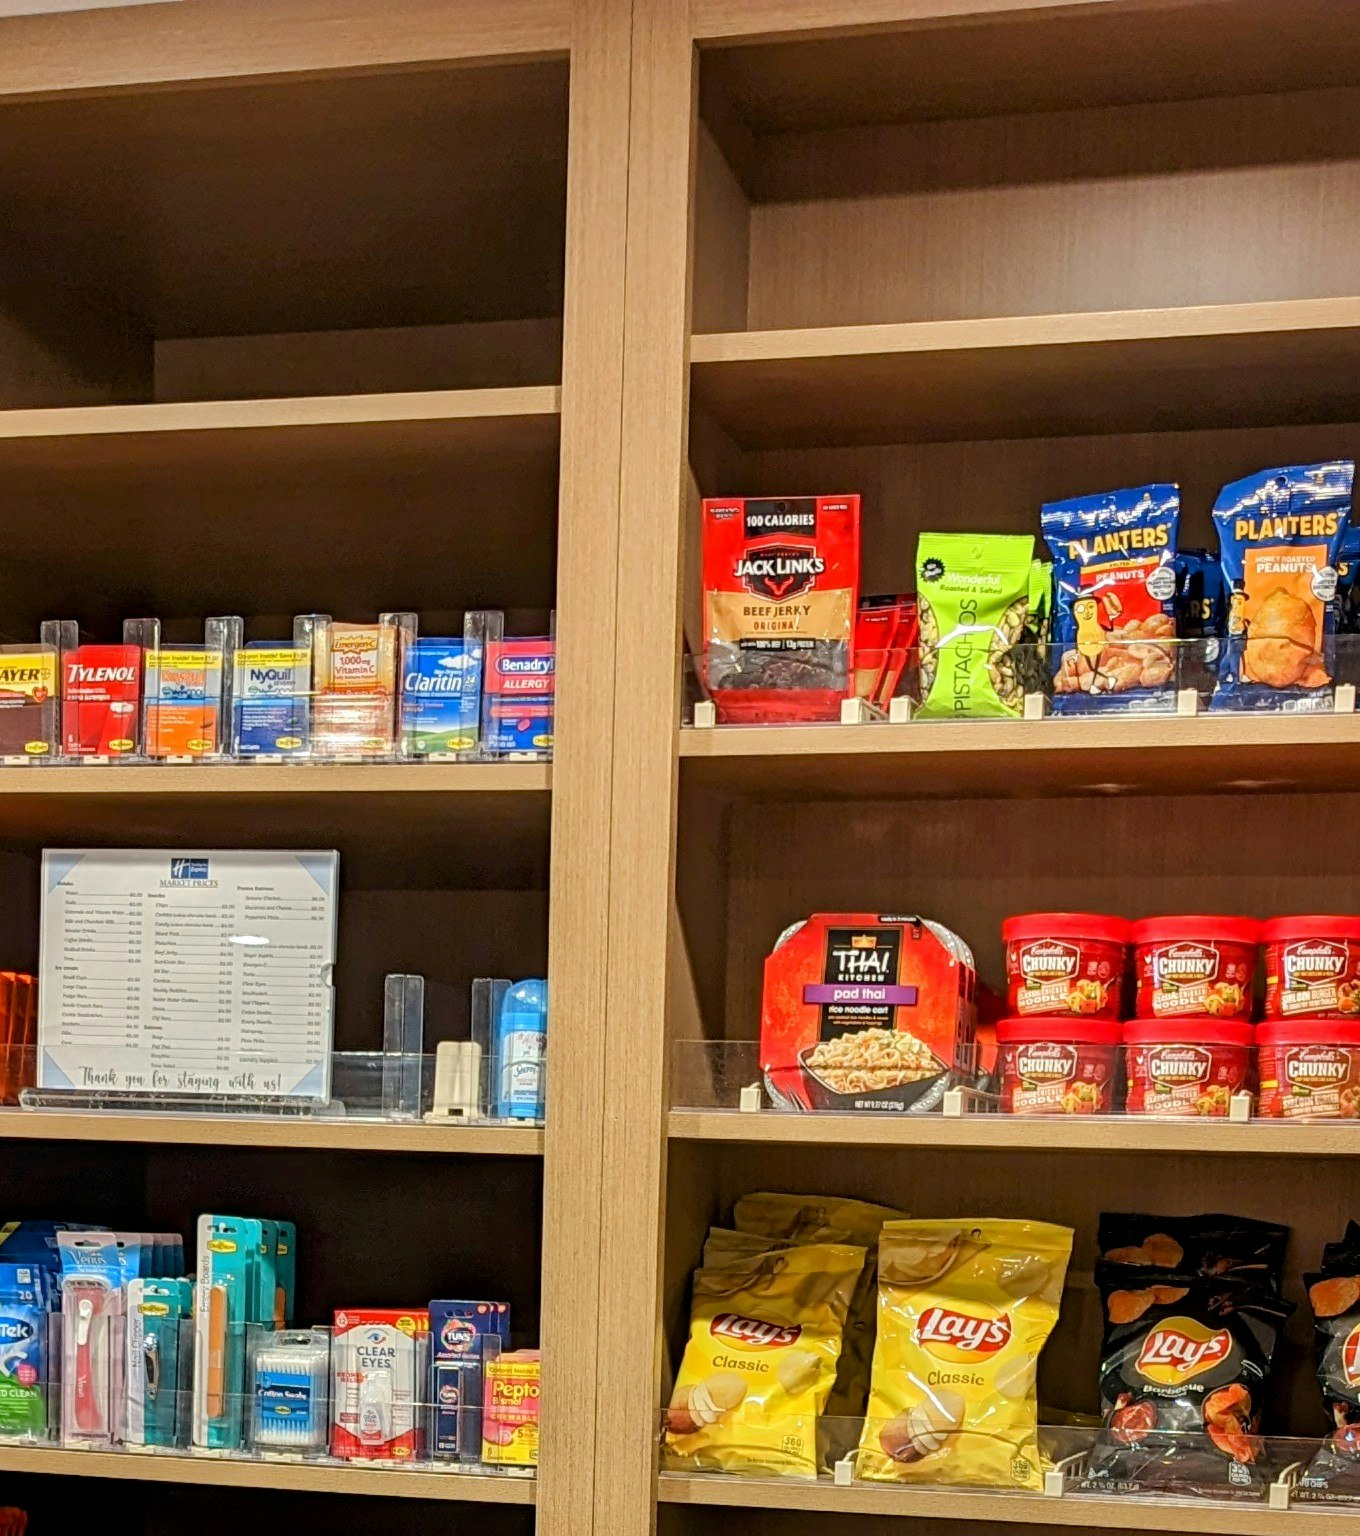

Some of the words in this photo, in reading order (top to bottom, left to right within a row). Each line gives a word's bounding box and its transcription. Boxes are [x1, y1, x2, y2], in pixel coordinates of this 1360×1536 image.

[746, 515, 764, 527] 100
[765, 514, 814, 526] CALORIES
[1236, 512, 1338, 540] PLANTERS
[1069, 526, 1169, 559] PLANTERS
[734, 558, 773, 577] JACK
[1257, 562, 1315, 575] PEANUTS
[947, 572, 1001, 585] Wonderful
[1096, 569, 1145, 583] PEANUTS
[743, 605, 771, 617] BEEF
[772, 605, 812, 617] JERKY
[67, 664, 136, 684] TYLENOL
[250, 669, 291, 683] NyQuil
[405, 672, 462, 692] Claritin
[503, 679, 550, 689] ALLERGY
[833, 950, 890, 974] THAI
[1022, 956, 1075, 972] CHUNKY
[1158, 958, 1213, 975] CHUNKY
[1288, 956, 1344, 973] CHUNKY
[838, 974, 885, 982] KITCHEN
[833, 988, 859, 1002] pad
[862, 988, 886, 1000] thai
[844, 1005, 871, 1014] noodle
[1018, 1058, 1072, 1074] CHUNKY
[1151, 1061, 1205, 1078] CHUNKY
[1289, 1062, 1347, 1079] CHUNKY
[70, 1251, 106, 1266] Venus
[712, 1314, 800, 1348] Lay's
[920, 1308, 1010, 1350] Lay's
[356, 1346, 395, 1358] CLEAR
[1143, 1330, 1226, 1371] Lay's
[361, 1357, 391, 1369] EYES
[712, 1355, 769, 1374] Classic
[927, 1370, 985, 1387] Classic
[492, 1380, 539, 1400] Pepto
[1143, 1383, 1205, 1396] Barbecue
